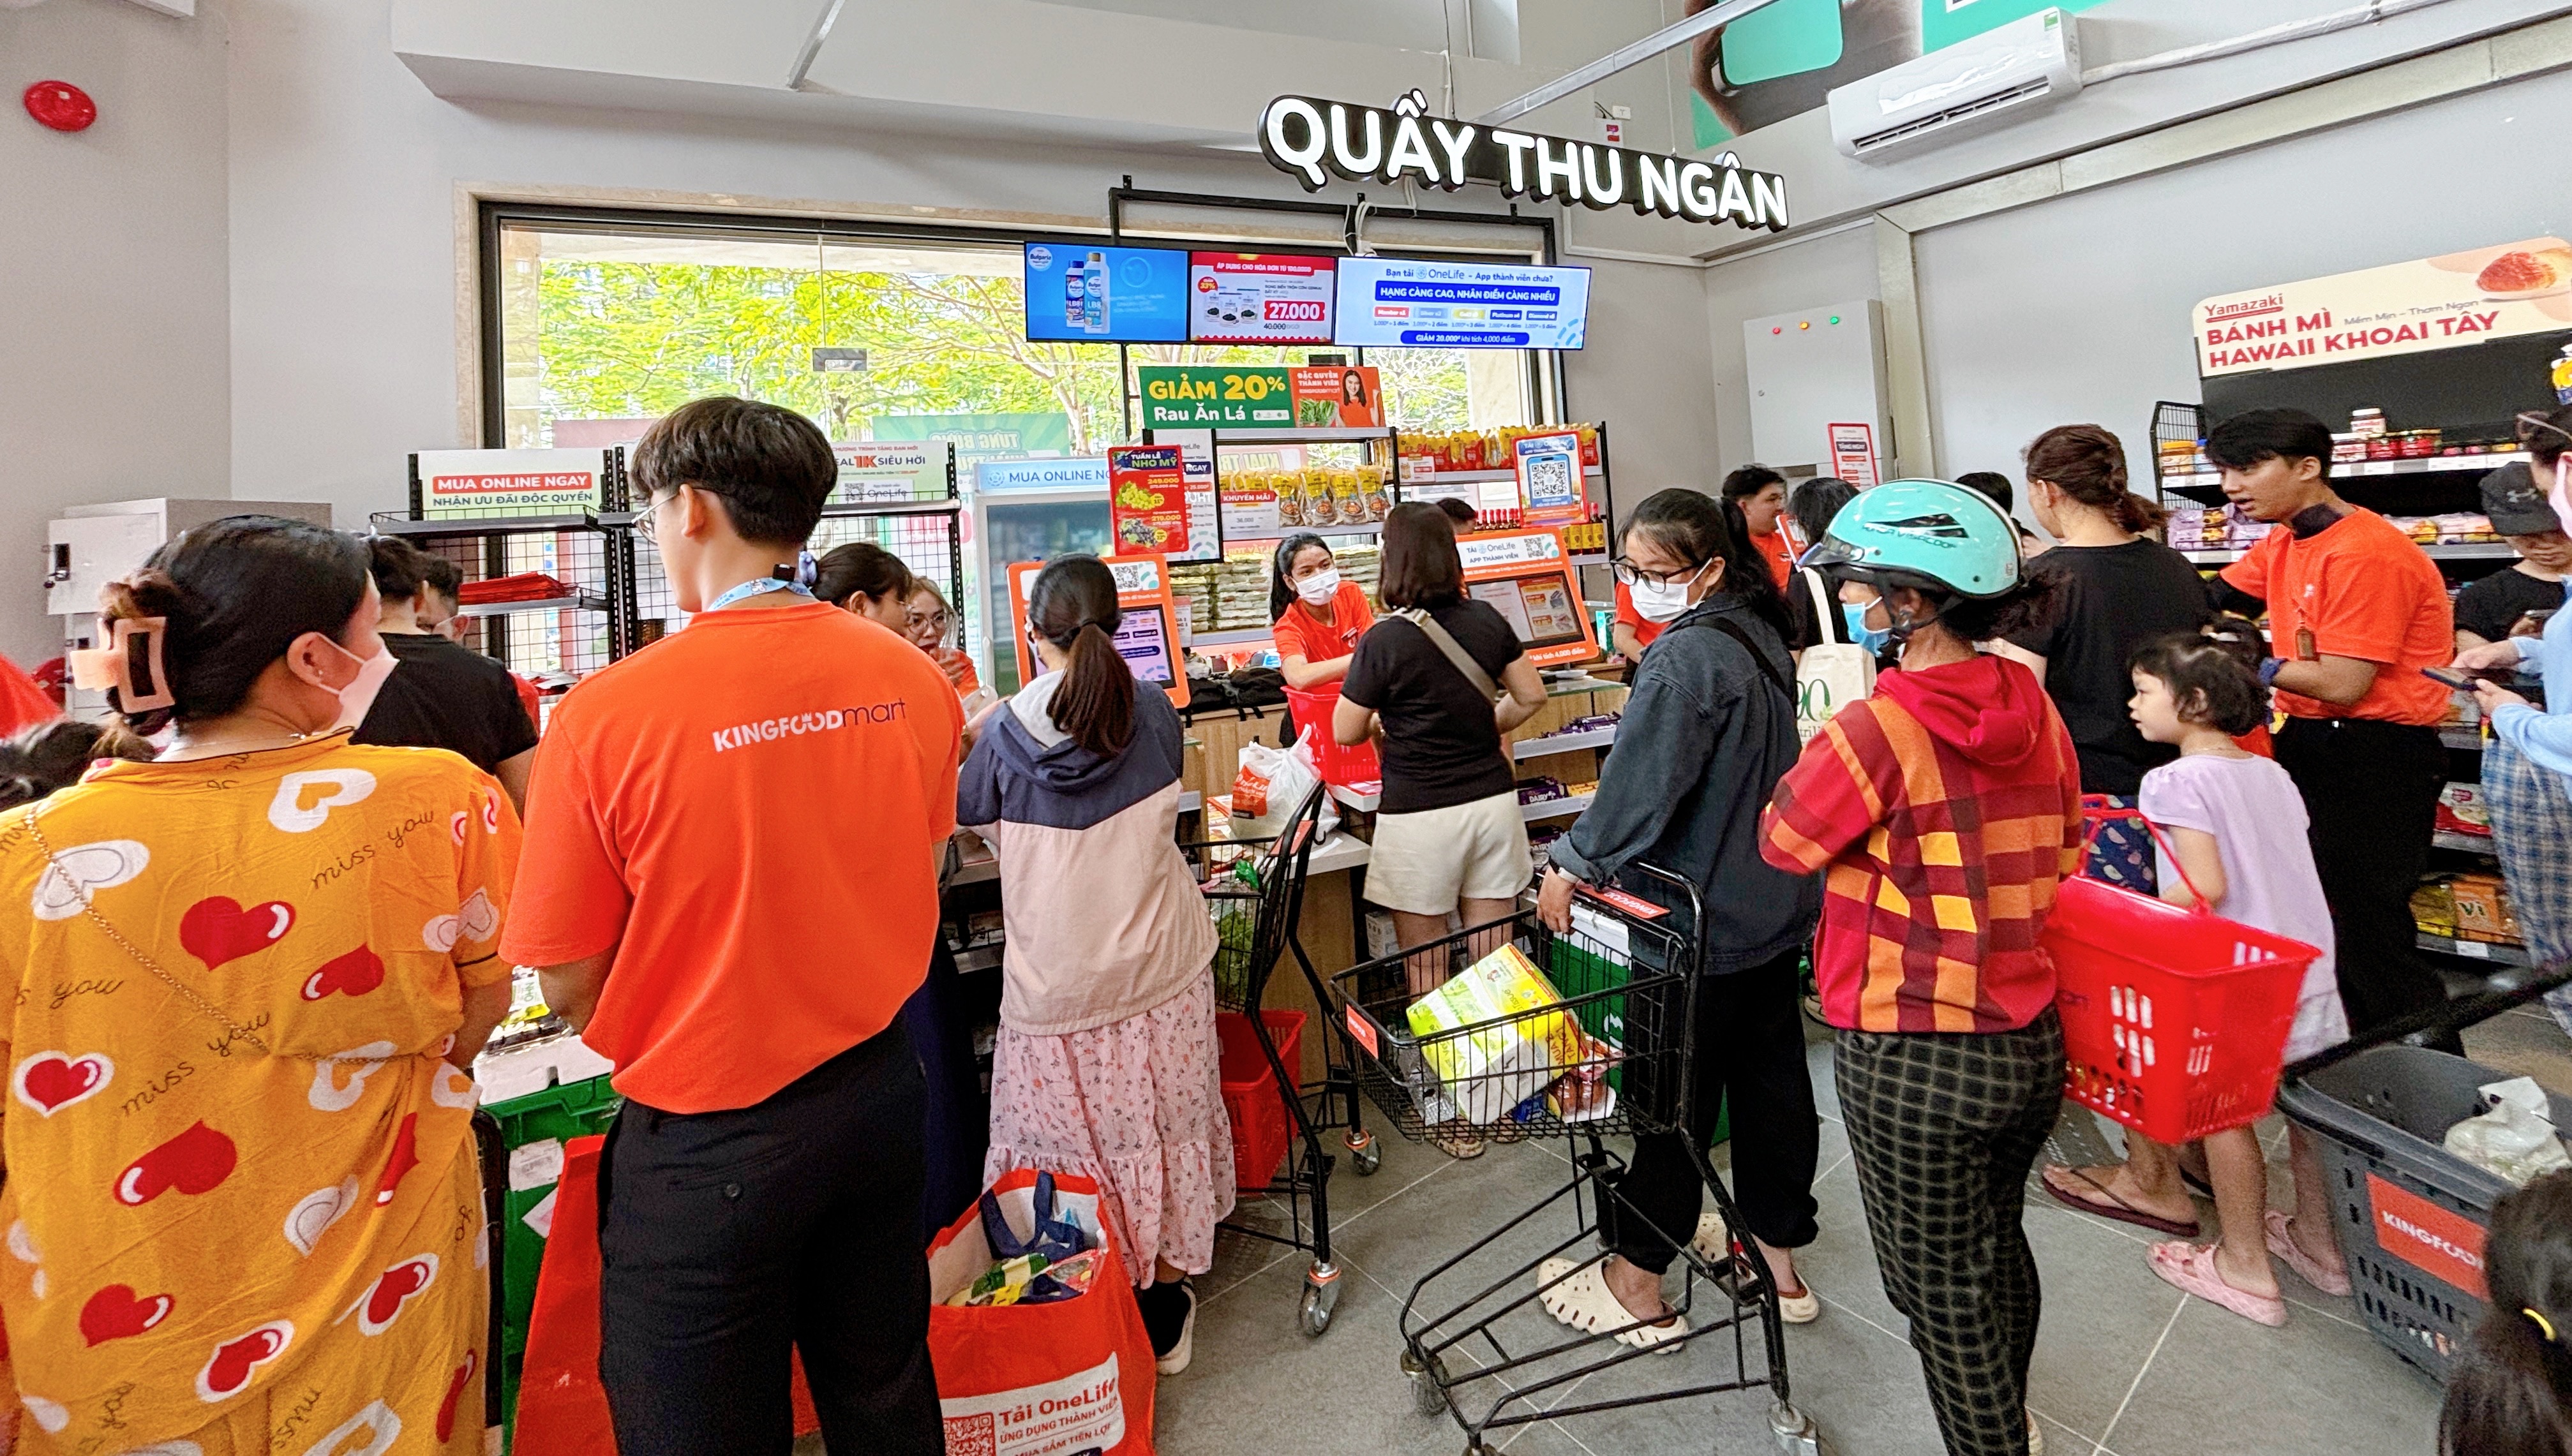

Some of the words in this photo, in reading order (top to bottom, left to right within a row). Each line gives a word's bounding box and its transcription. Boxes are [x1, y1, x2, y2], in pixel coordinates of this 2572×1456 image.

[1267, 88, 1476, 187] QUẦY
[1491, 130, 1624, 205] THU
[1638, 150, 1788, 227] NGÂN
[1386, 269, 1401, 278] Bạn
[1403, 269, 1414, 277] tải
[1428, 269, 1465, 279] OneLife
[1475, 272, 1490, 281] App
[1516, 273, 1530, 281] viên
[1380, 287, 1407, 299] HẠNG
[1409, 286, 1433, 297] CÀNG
[1435, 290, 1455, 299] CAO,
[1483, 288, 1504, 299] ĐIỂM
[1506, 290, 1530, 300] CÀNG
[1269, 303, 1320, 320] 27.000
[2204, 293, 2283, 317] Yamazaki
[2375, 311, 2396, 322] Mịn
[2446, 299, 2479, 311] Ngon
[2207, 318, 2287, 346] BÁNH
[2296, 308, 2332, 332] MÌ
[1416, 333, 1435, 342] GIẢM
[2209, 338, 2316, 368] HAWAII
[2325, 321, 2428, 352] KHOAI
[2436, 310, 2500, 336] TÂY
[1313, 370, 1338, 378] QUYỀN
[1149, 373, 1217, 401] GIẢM
[1223, 375, 1286, 401] 20%
[1154, 406, 1190, 422] Rau
[1195, 403, 1220, 422] Ăn
[1225, 405, 1245, 421] Lá
[837, 458, 855, 466] EAL
[854, 455, 878, 468] 1K
[878, 455, 902, 466] SIÊU
[906, 454, 926, 464] HỜI
[1159, 457, 1178, 466] MỸ
[438, 478, 477, 491] MUA
[481, 477, 541, 489] ONLINE
[544, 475, 588, 487] NGAY
[1009, 472, 1041, 482] MUA
[1043, 470, 1092, 481] ONLINE
[433, 495, 471, 508] NHẬN
[474, 495, 493, 505] ƯU
[495, 493, 518, 504] ĐÃI
[521, 493, 549, 505] ĐỘC
[551, 491, 593, 503] QUYỀN
[867, 488, 907, 498] OneLife
[1223, 493, 1255, 501] KHUYẾN
[1487, 542, 1516, 552] OneLife
[1483, 554, 1504, 562] THÀNH
[712, 697, 906, 752] KINGFOODmart
[1529, 792, 1549, 803] DAIRY
[311, 844, 376, 889] miss
[387, 810, 434, 849] you
[49, 980, 124, 1010] you
[121, 1061, 195, 1117] miss
[206, 1011, 271, 1057] you
[999, 1402, 1033, 1427] Tải
[1000, 1427, 1024, 1445] ỨNG
[1026, 1420, 1057, 1437] DỤNG
[1058, 1409, 1096, 1426] THÀNH
[1068, 1432, 1092, 1444] TIỆN
